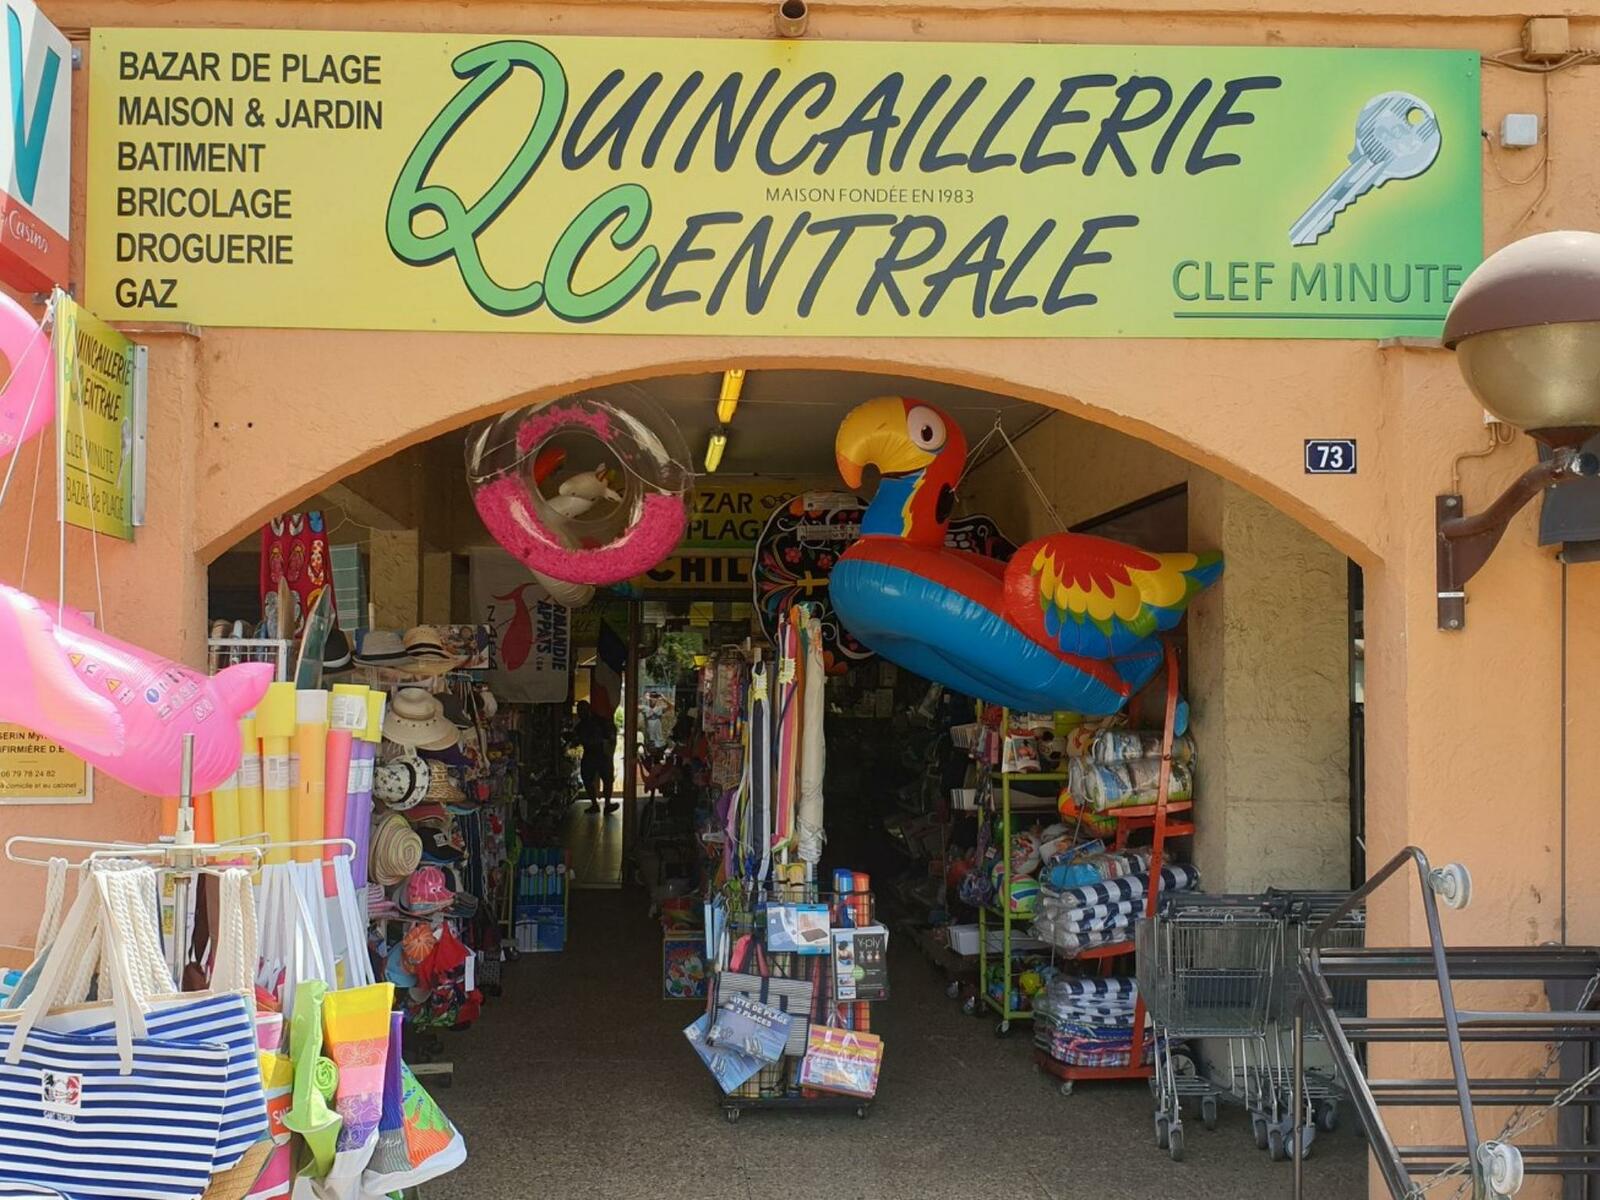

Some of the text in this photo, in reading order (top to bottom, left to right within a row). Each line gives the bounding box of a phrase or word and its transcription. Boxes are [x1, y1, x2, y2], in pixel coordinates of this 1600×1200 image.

[119, 51, 381, 84] BAZAR DE PLAGE
[118, 96, 382, 129] MAISON & JARDIN
[118, 141, 266, 172] BATIMENT
[386, 40, 1281, 316] QUINCAILLERIE
[117, 187, 292, 219] BRICOLAGE
[766, 185, 974, 204] MAISON FONDÉE EN 1983
[116, 232, 293, 265] DROGUERIE
[544, 183, 1139, 323] CENTRALE
[116, 278, 178, 308] GAZ
[1172, 260, 1463, 303] CLEF MINUTE
[1317, 445, 1343, 468] 73
[686, 519, 766, 541] PLAG
[0, 744, 46, 753] FIRMIÈRE
